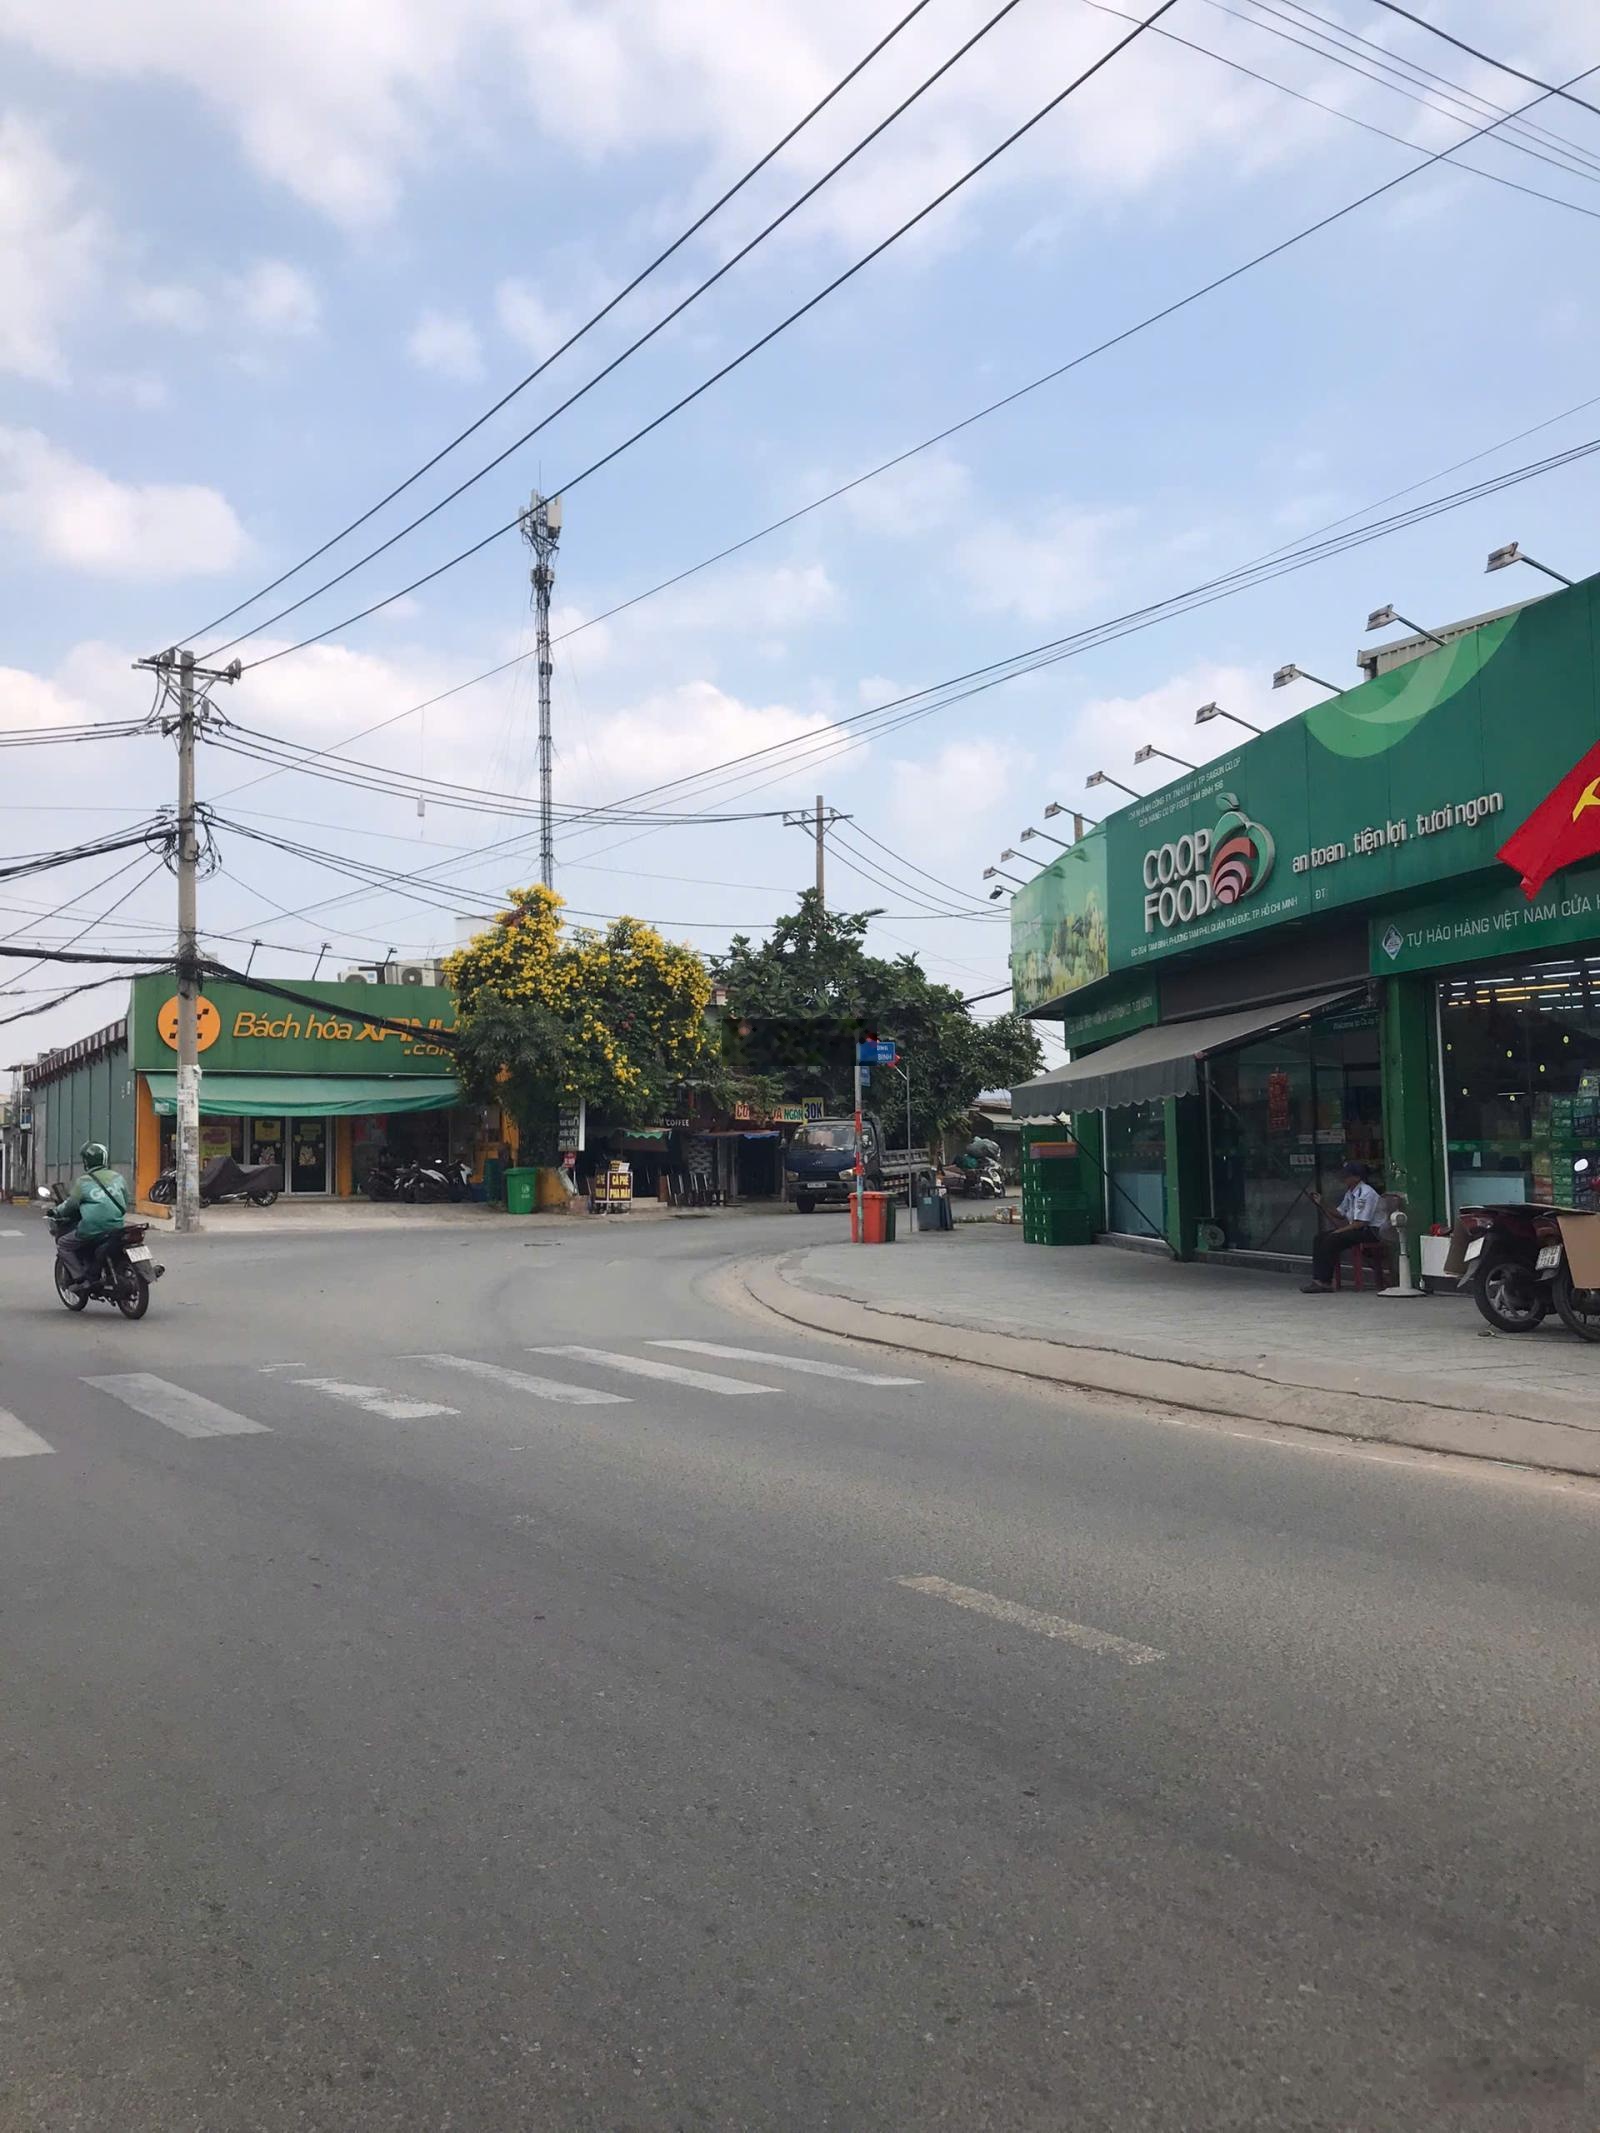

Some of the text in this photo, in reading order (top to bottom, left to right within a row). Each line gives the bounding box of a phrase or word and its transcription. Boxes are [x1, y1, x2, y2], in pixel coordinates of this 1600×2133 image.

[1143, 828, 1213, 890] CO.OP
[1292, 855, 1309, 873] an
[1353, 826, 1385, 856] tiện
[1386, 817, 1408, 848] lợi
[1416, 803, 1453, 836] tươi
[1455, 791, 1504, 827] ngon
[1406, 930, 1422, 948] TỰ
[1426, 924, 1451, 944] HÀO
[1454, 917, 1490, 938] HÀNG
[1492, 909, 1520, 931] VIỆT
[1523, 904, 1557, 924] NAM
[1561, 894, 1592, 917] CỬA
[232, 1011, 301, 1039] Bách
[305, 1013, 354, 1040] hóa
[804, 1102, 823, 1119] 30K
